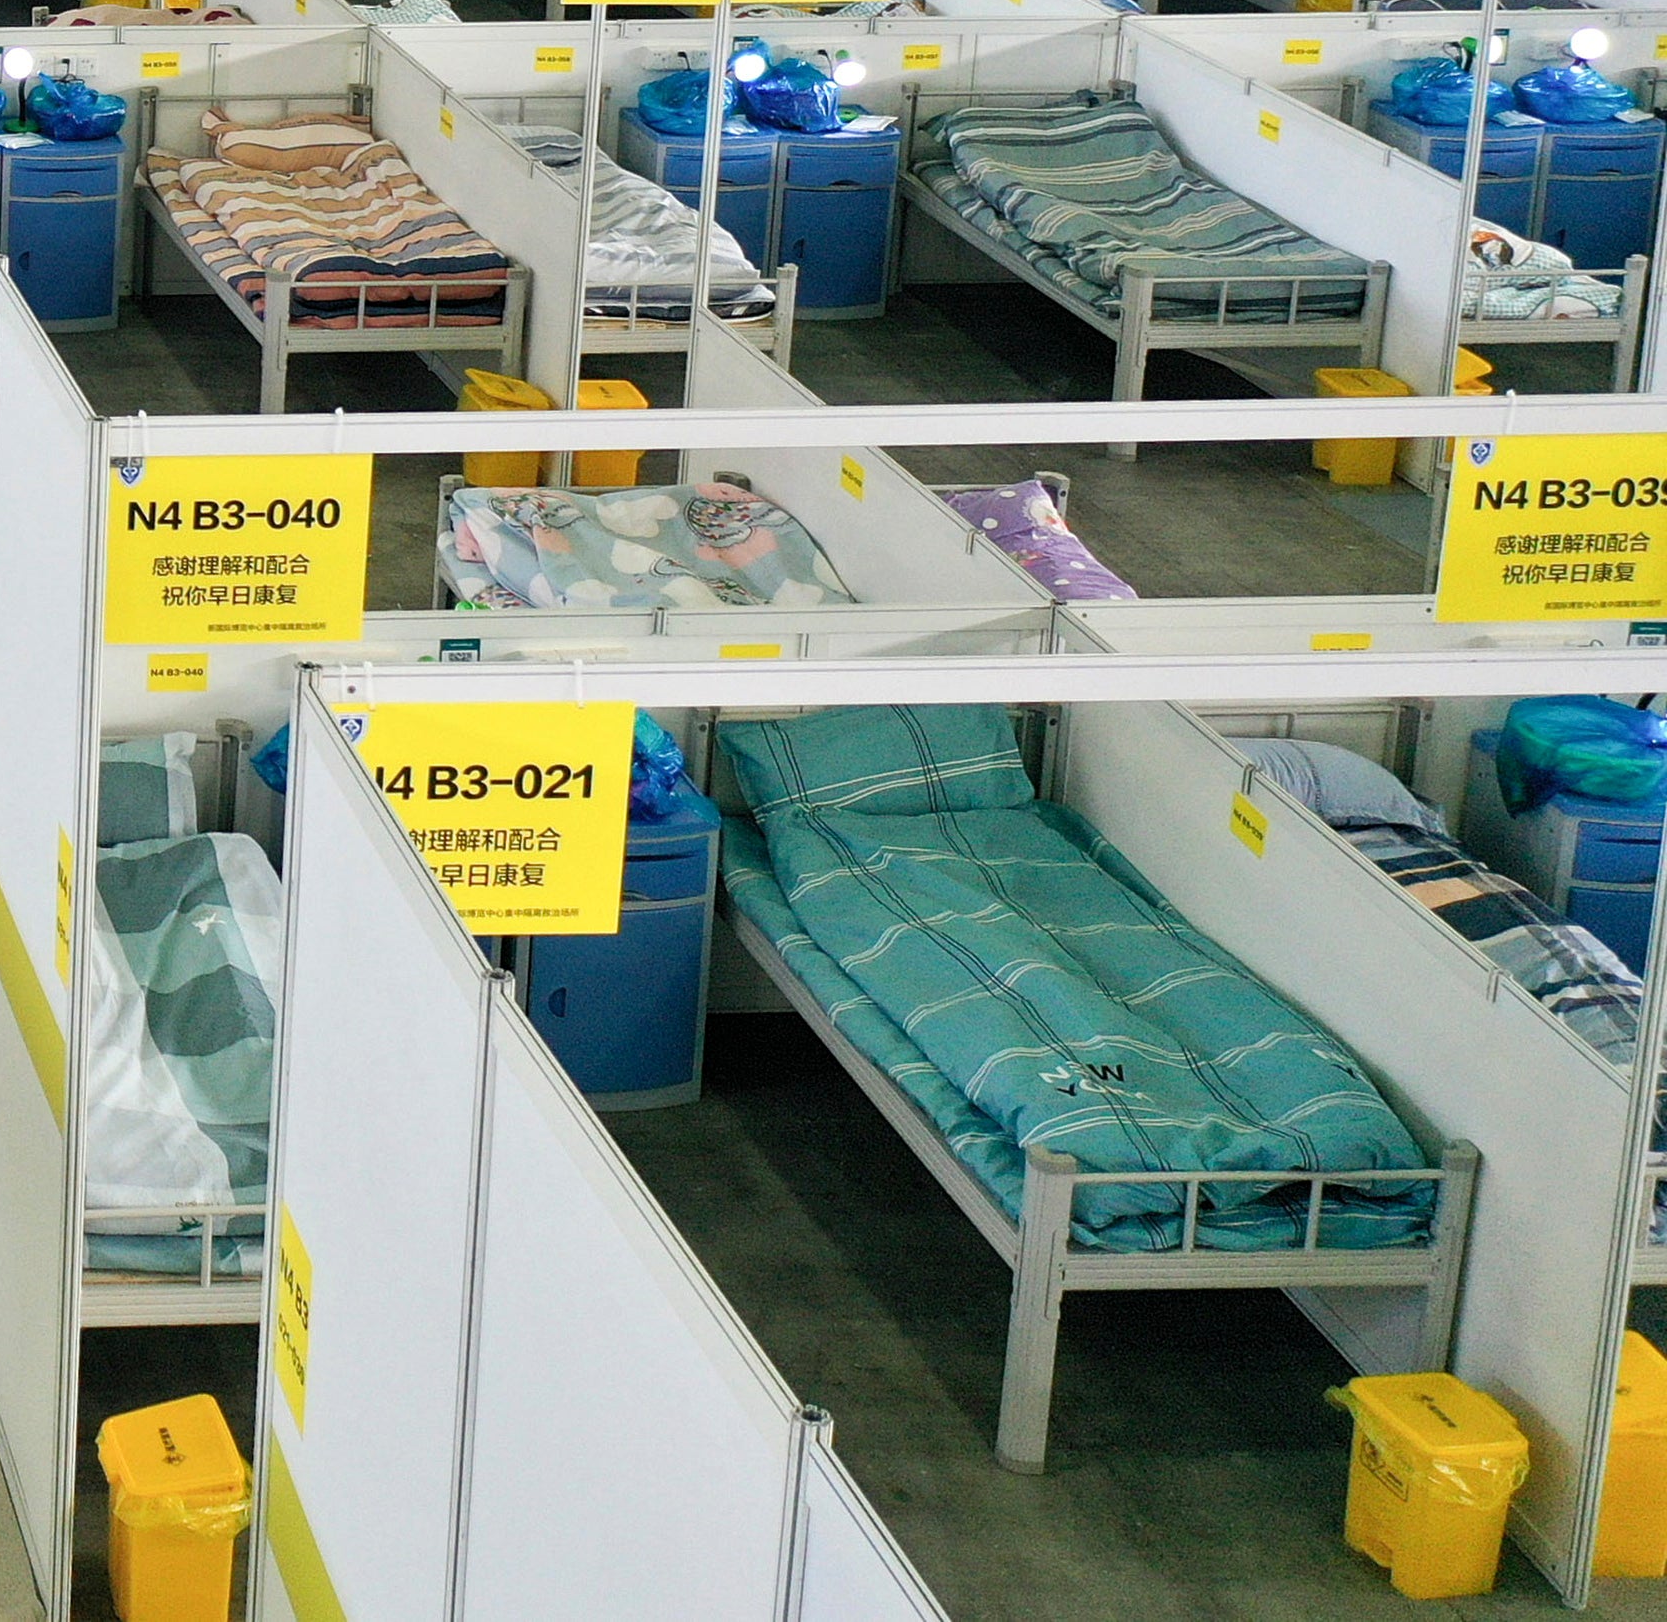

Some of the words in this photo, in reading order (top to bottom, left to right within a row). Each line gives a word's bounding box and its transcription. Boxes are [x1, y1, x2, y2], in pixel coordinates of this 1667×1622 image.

[1475, 481, 1528, 510] N4
[128, 502, 182, 530] N4
[193, 499, 340, 530] B3-040
[1495, 532, 1650, 555] 感谢理解和配合
[153, 554, 310, 576] 感谢理解和配合
[1503, 562, 1635, 584] 祝你早日康复
[162, 584, 297, 606] 祝你早日康复
[428, 765, 592, 799] B3-021
[408, 827, 561, 853] 谢理解和配合
[440, 863, 545, 888] 早日康复
